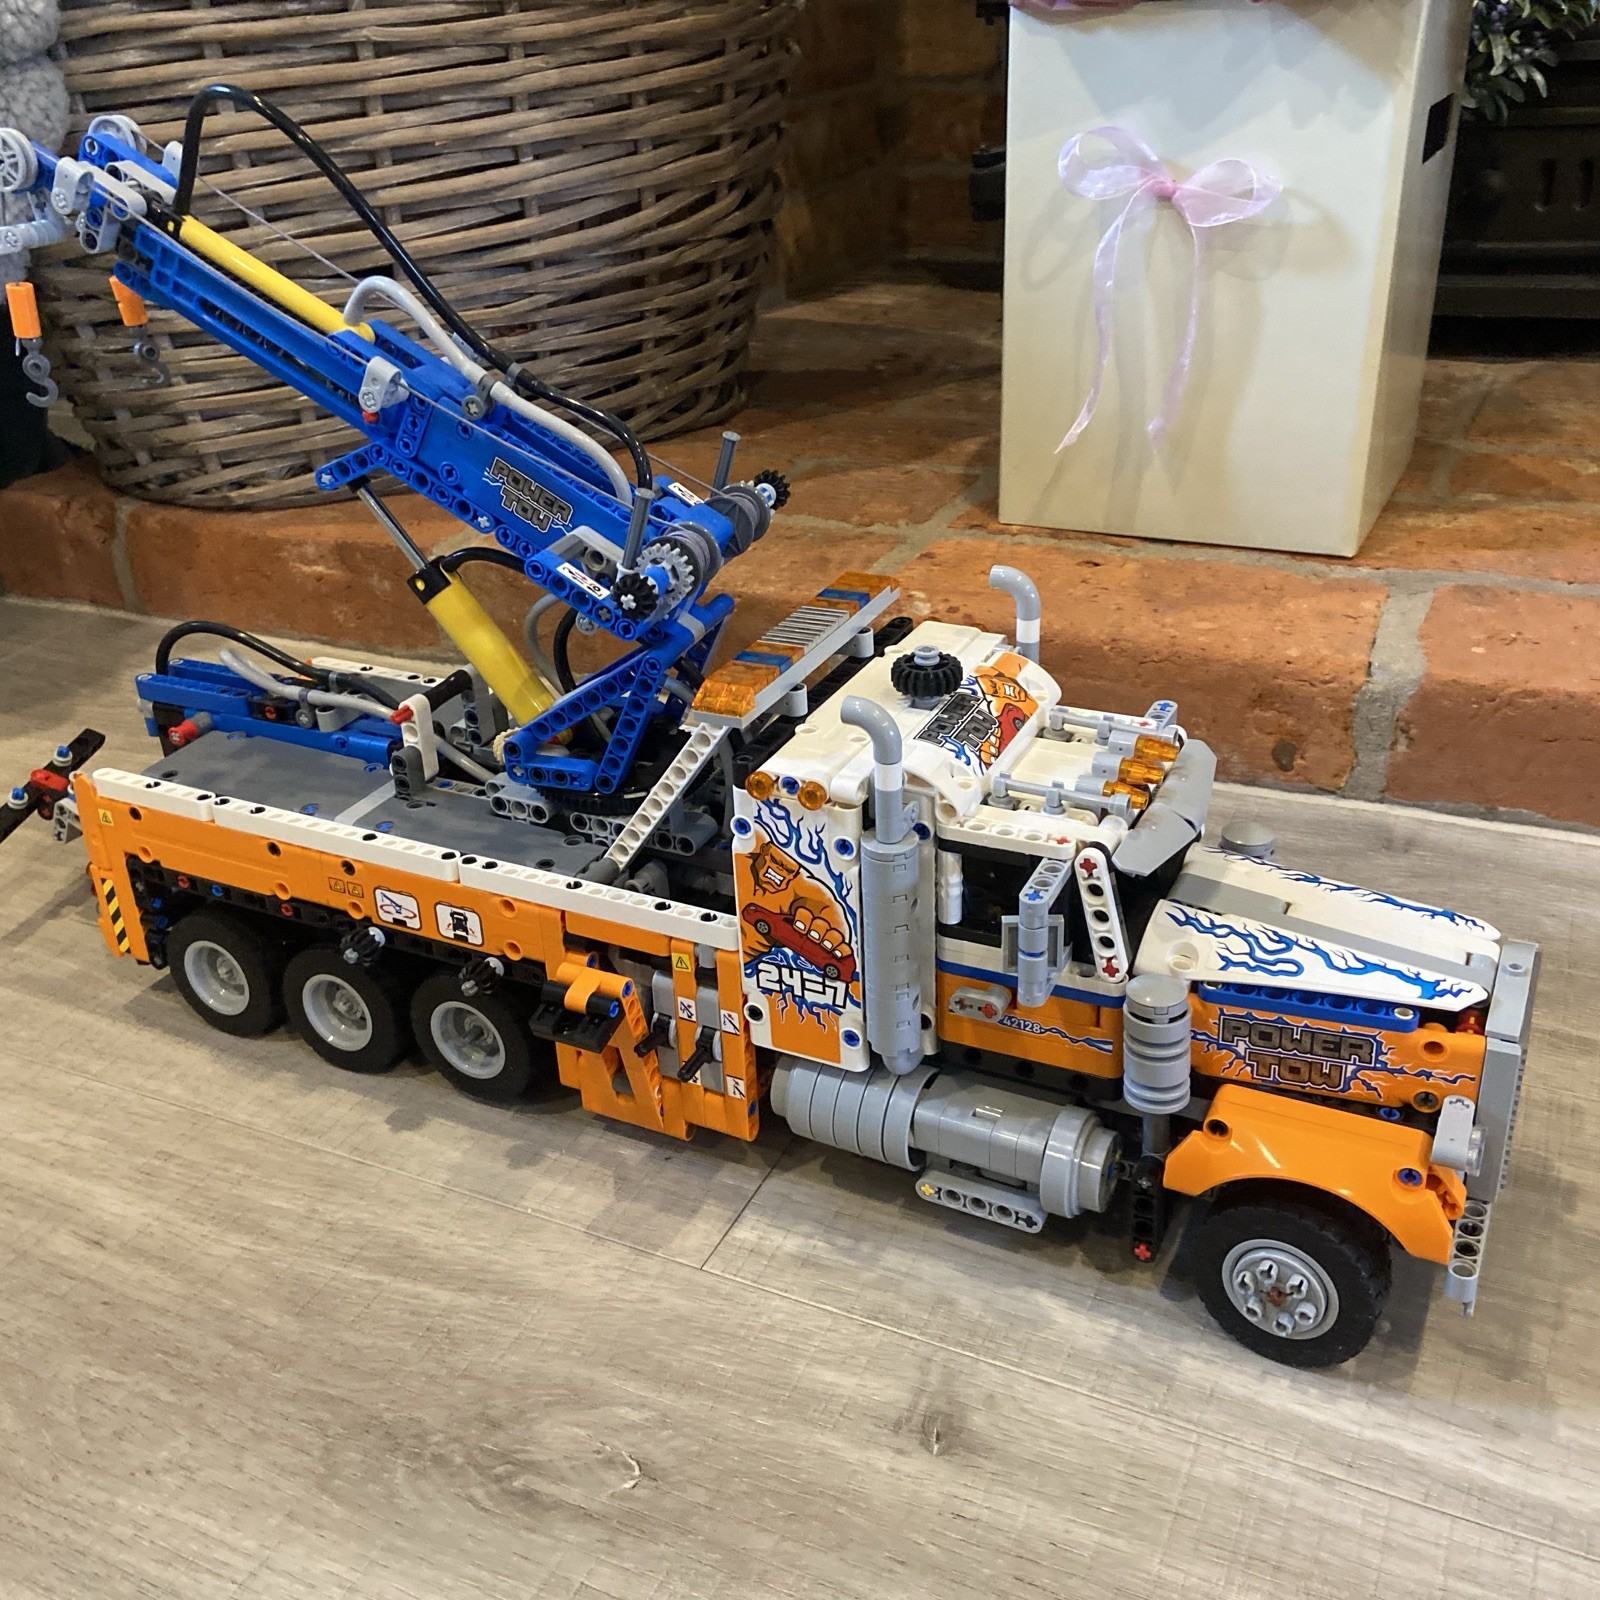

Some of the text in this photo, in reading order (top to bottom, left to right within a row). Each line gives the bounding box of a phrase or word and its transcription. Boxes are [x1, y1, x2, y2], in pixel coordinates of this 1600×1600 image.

[490, 457, 574, 525] POWER
[500, 486, 553, 533] TOW
[914, 692, 984, 748] POWER
[951, 707, 999, 752] TOW
[1002, 1015, 1041, 1034] 42128
[1219, 1015, 1376, 1067] POWER
[1245, 1050, 1346, 1092] TOW
